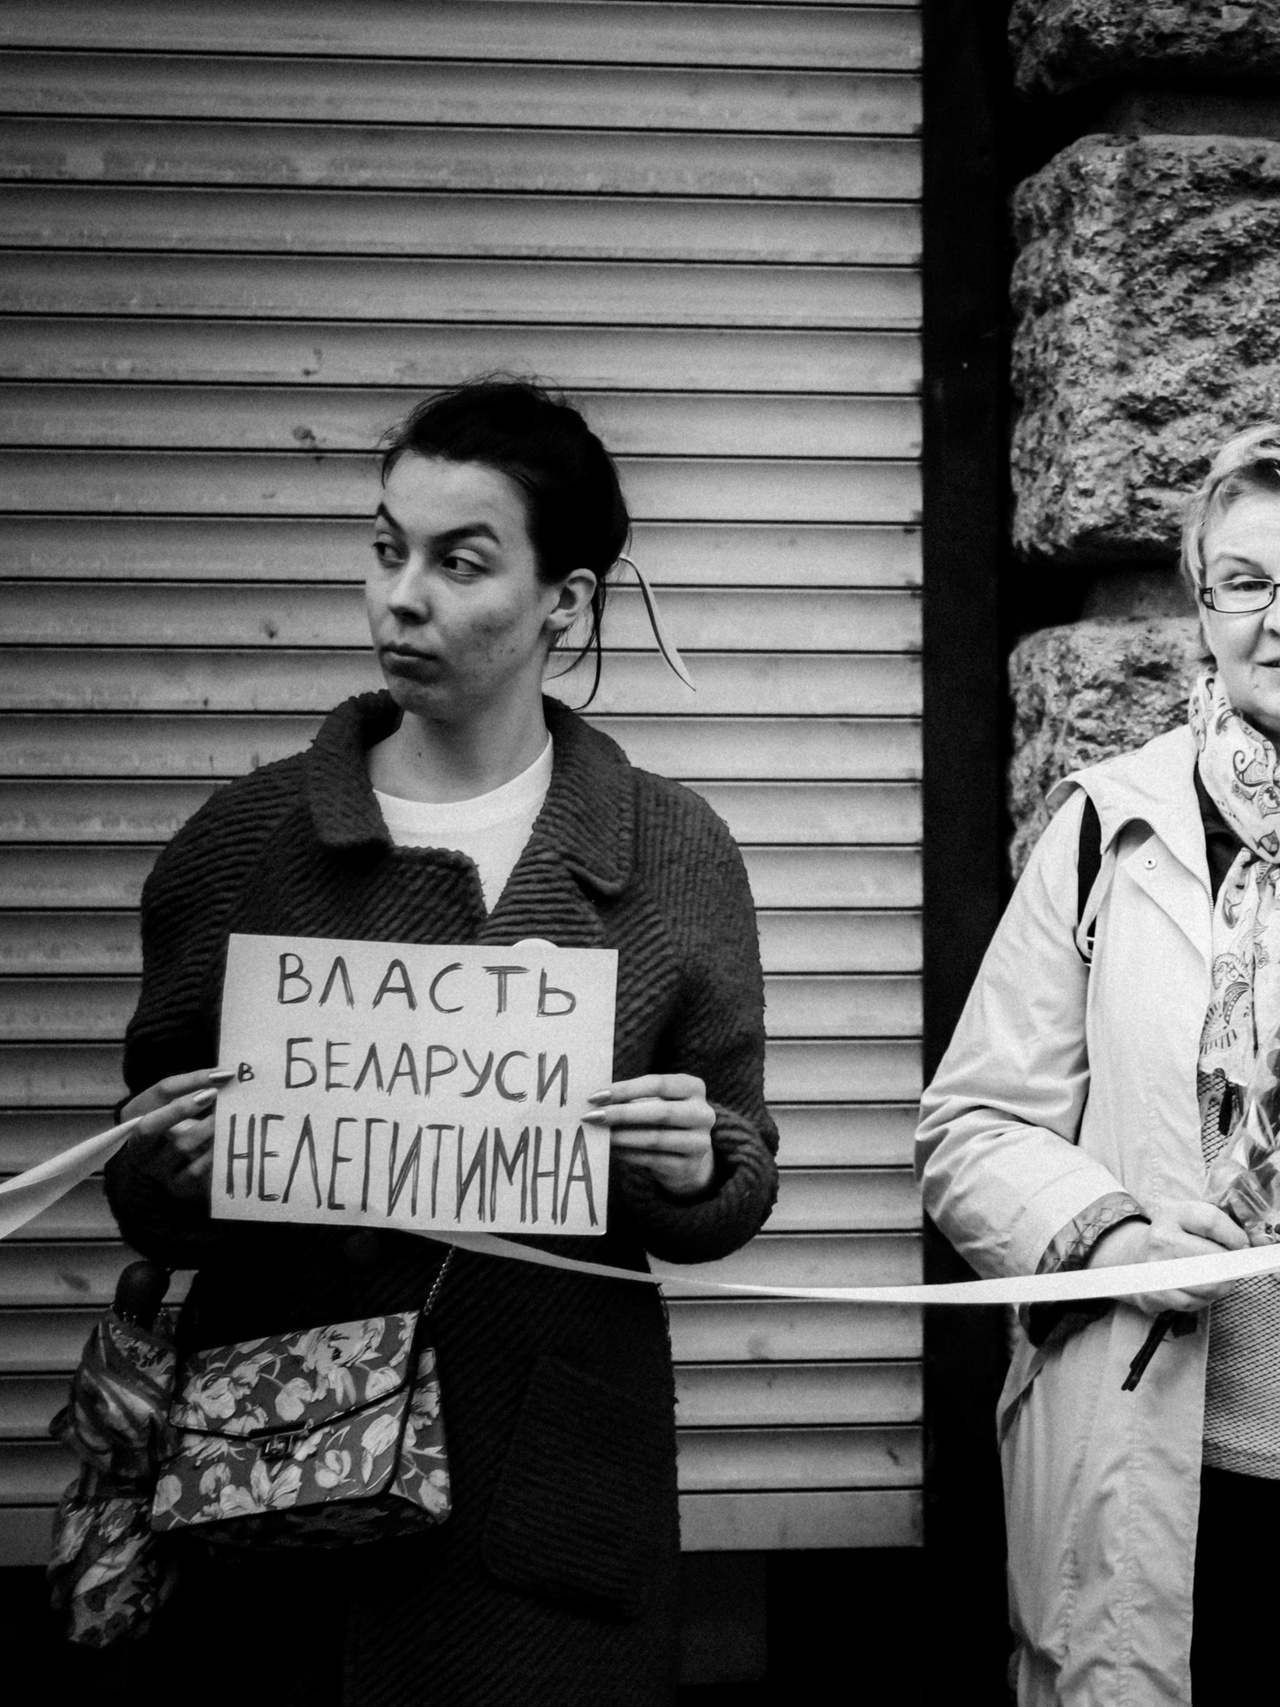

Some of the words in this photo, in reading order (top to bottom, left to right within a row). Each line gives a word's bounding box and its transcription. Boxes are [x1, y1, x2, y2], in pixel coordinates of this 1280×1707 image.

[277, 952, 577, 1017] ВЛАСТЬ
[285, 1037, 569, 1107] БЕЛАРУСИ
[226, 1113, 599, 1227] НЕЛЕГИТИМНА
